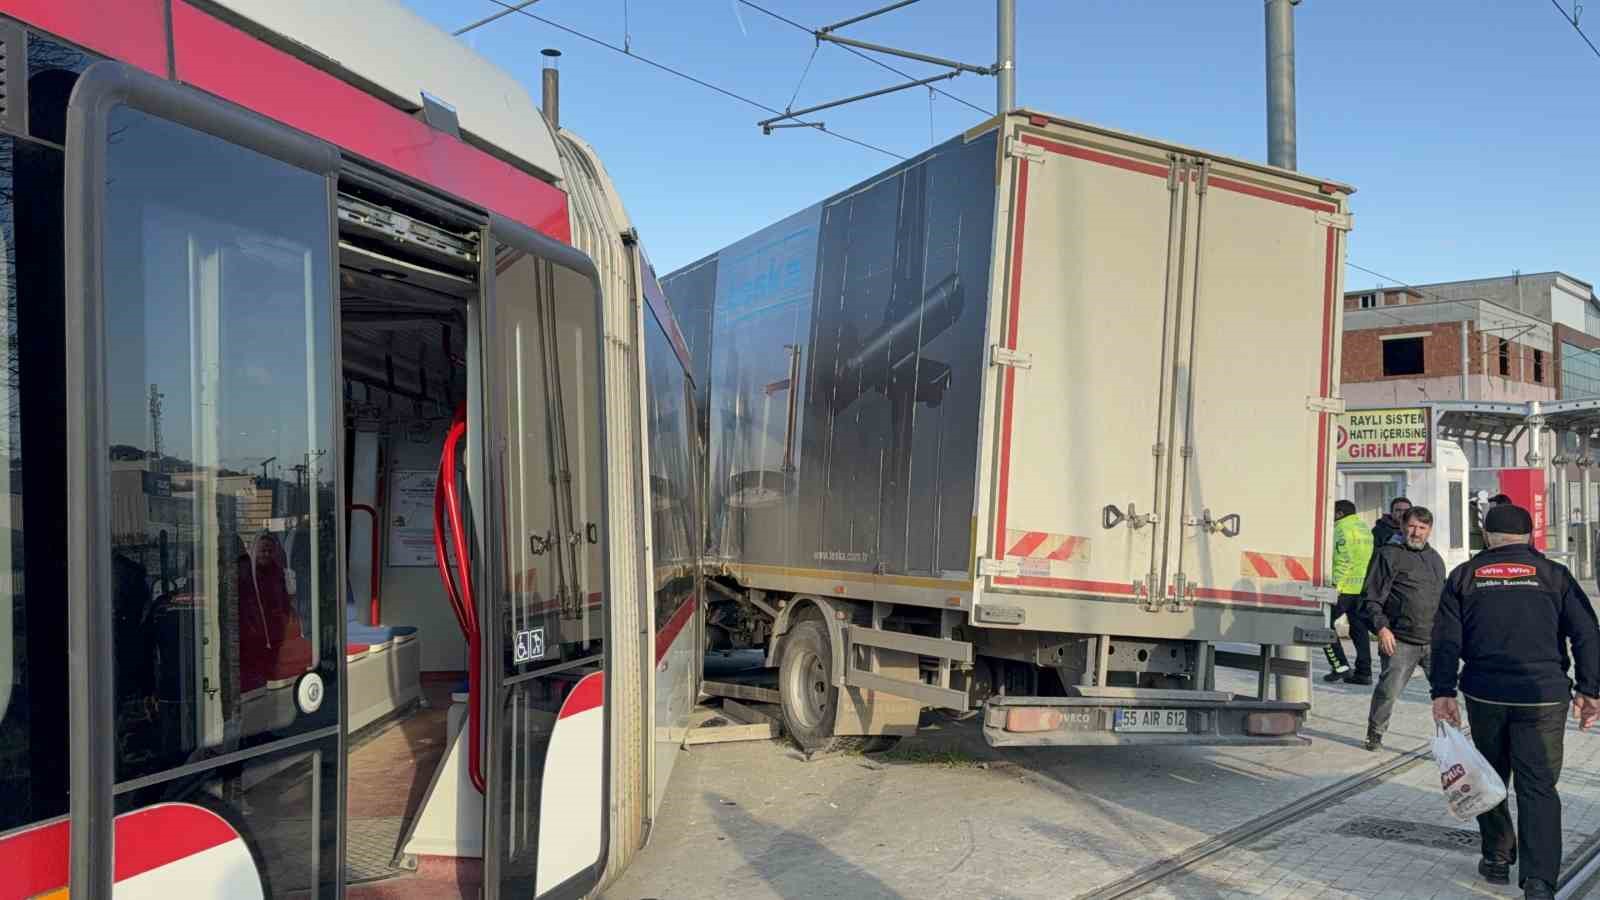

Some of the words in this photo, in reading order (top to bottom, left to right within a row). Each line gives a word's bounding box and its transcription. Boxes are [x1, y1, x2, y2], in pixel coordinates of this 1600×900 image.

[1350, 415, 1381, 426] RAYLI
[1350, 428, 1377, 439] HATTI
[1123, 711, 1137, 726] 55
[1142, 711, 1161, 726] AIR
[1166, 711, 1185, 726] 612
